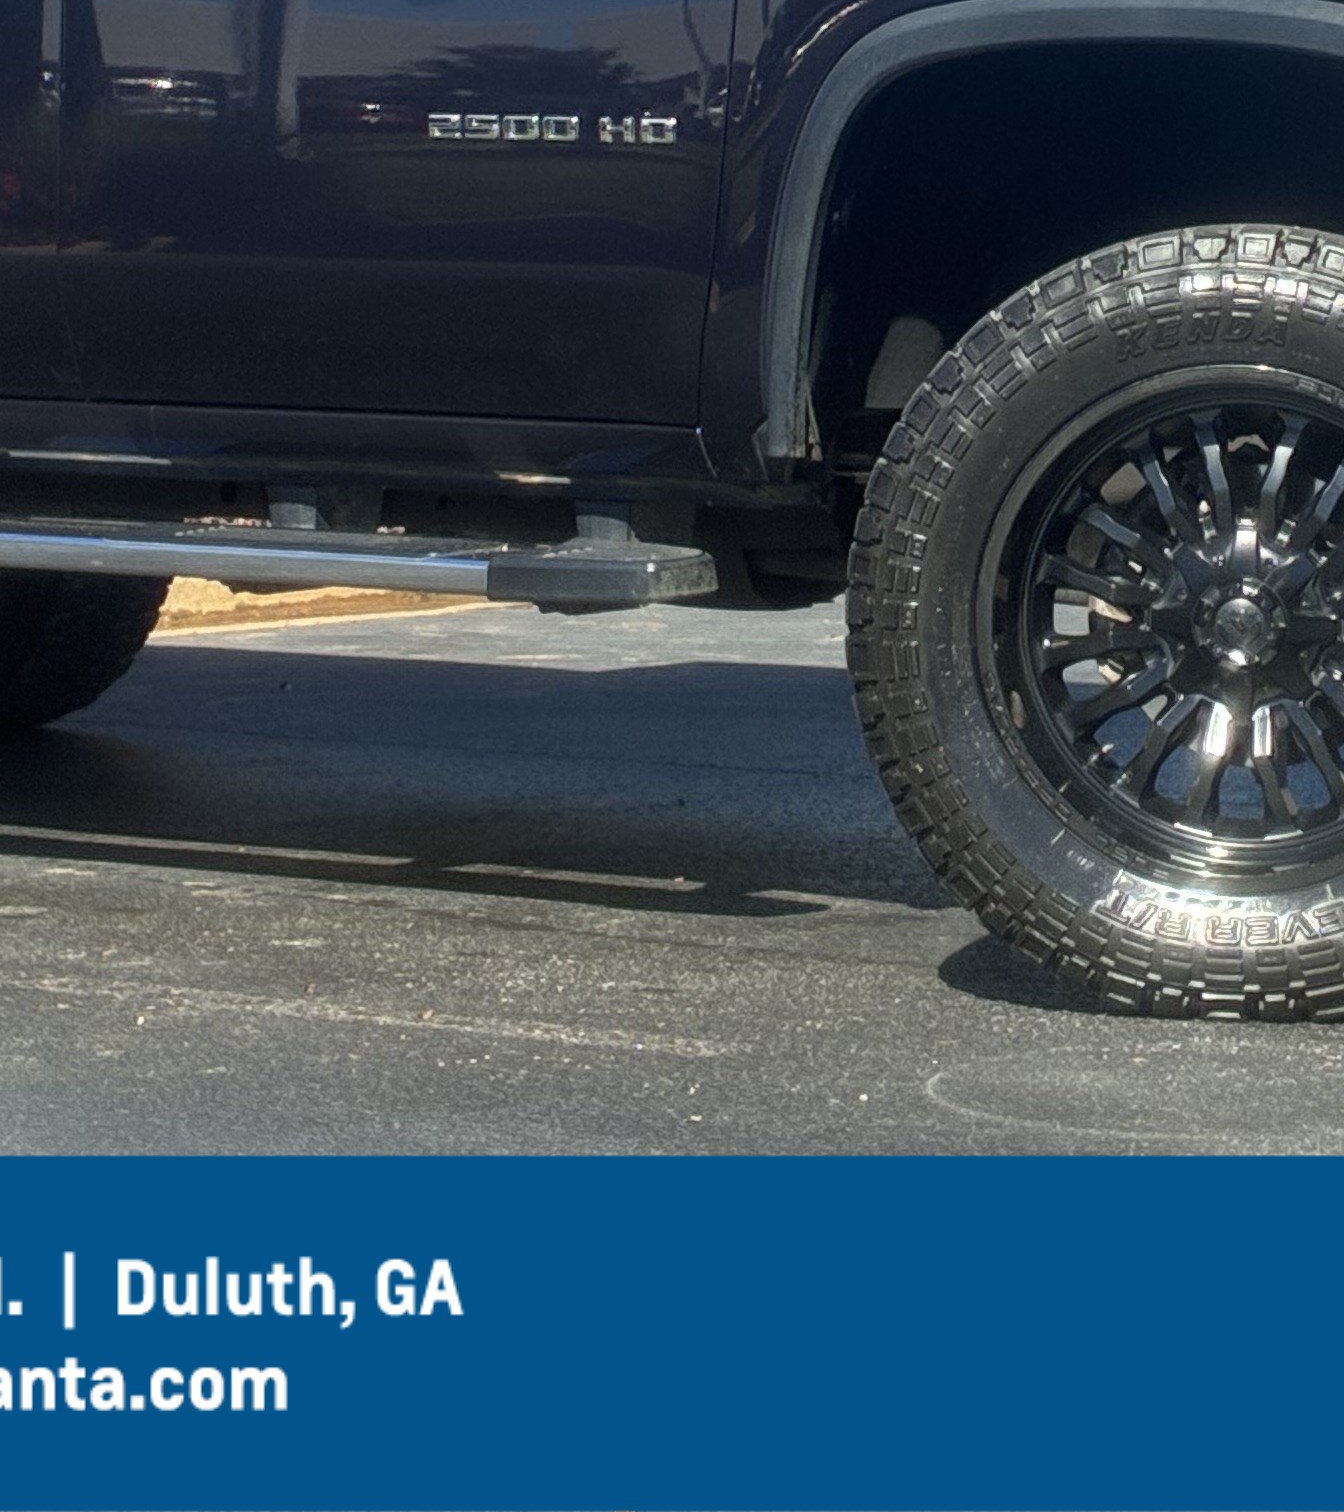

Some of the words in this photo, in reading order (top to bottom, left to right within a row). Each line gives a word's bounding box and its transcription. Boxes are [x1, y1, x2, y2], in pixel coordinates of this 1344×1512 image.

[428, 113, 580, 142] 2500
[598, 113, 677, 143] HD
[1115, 311, 1289, 362] KENDA
